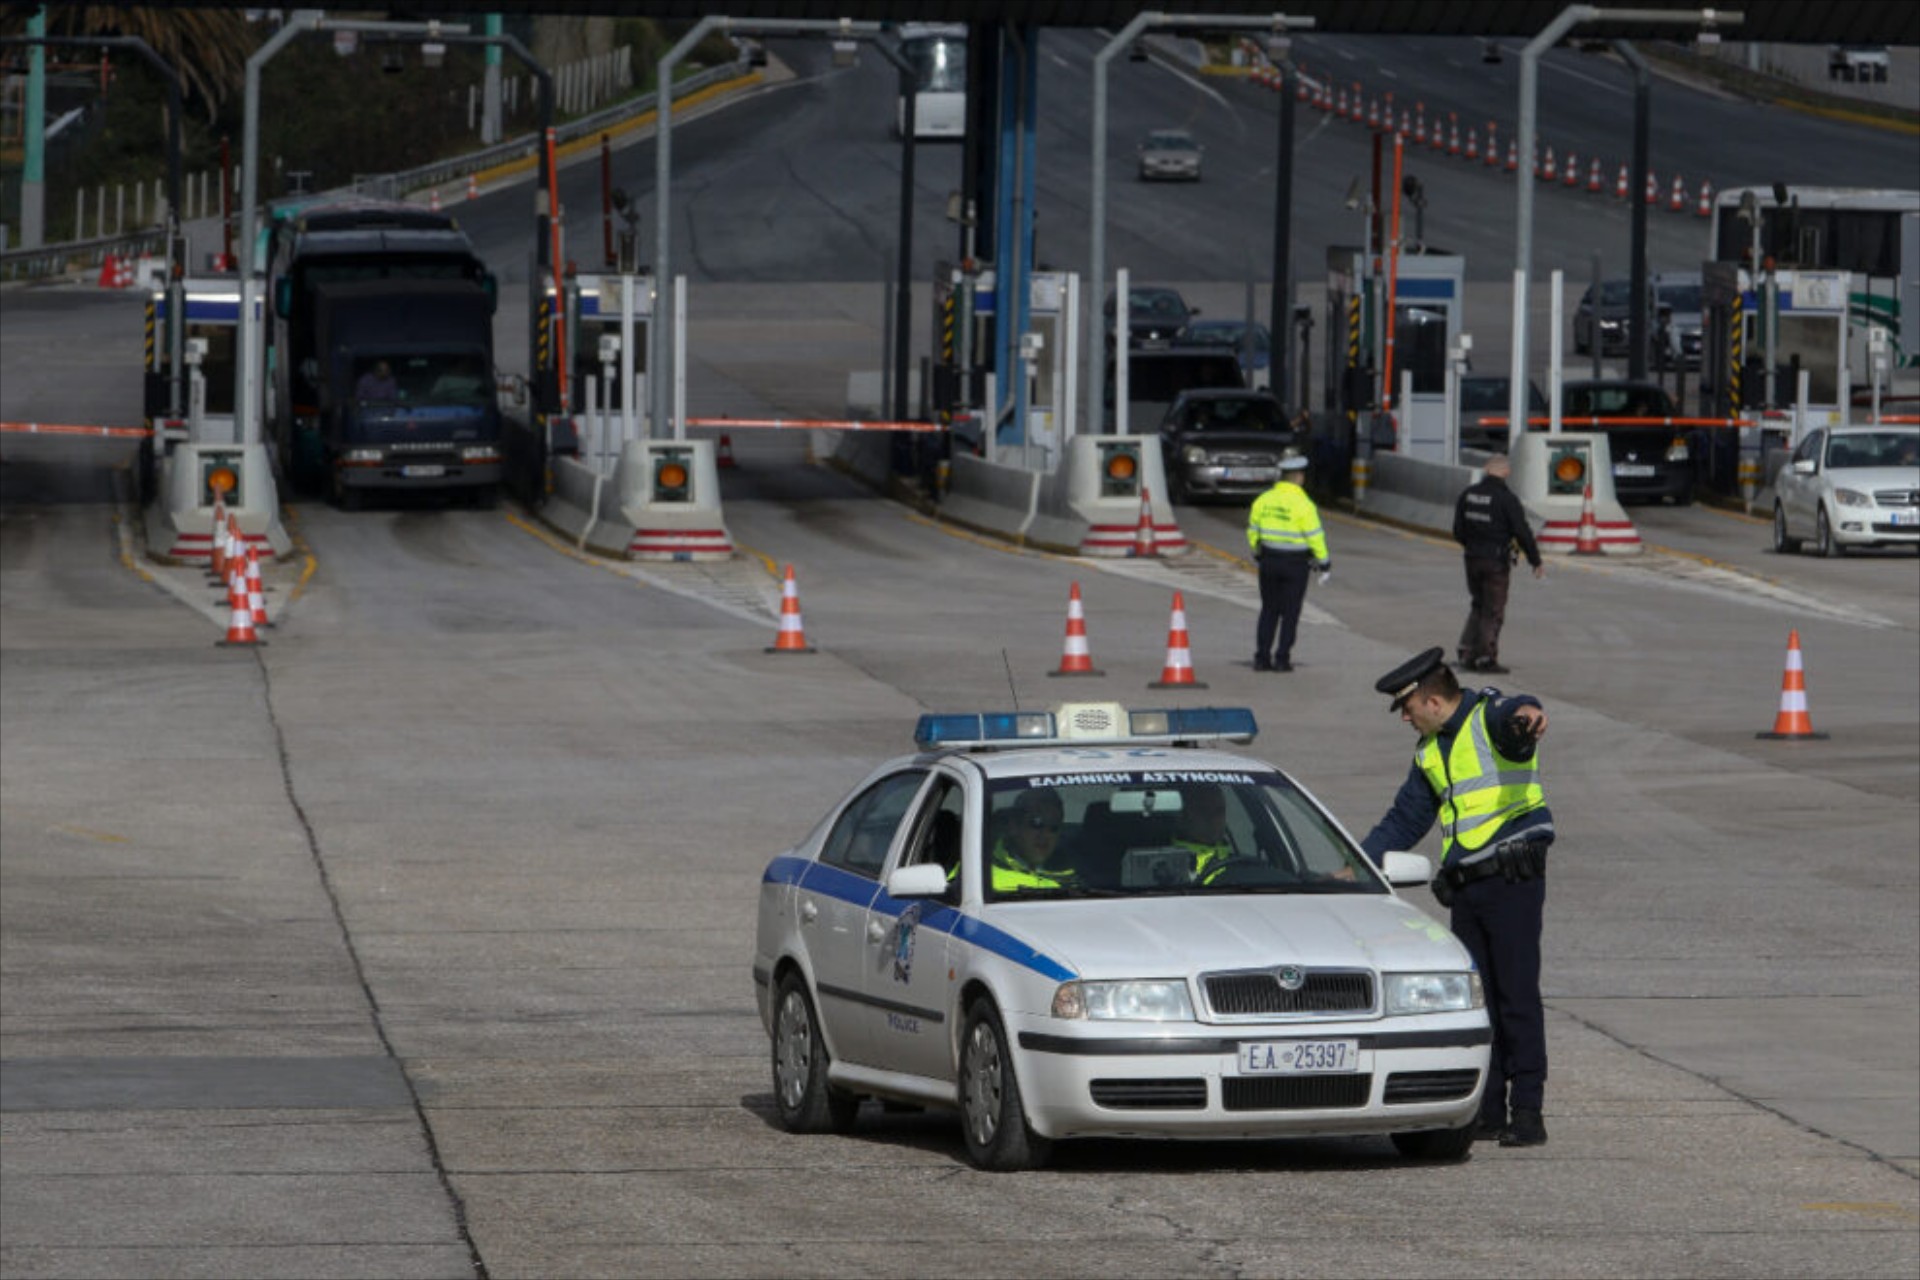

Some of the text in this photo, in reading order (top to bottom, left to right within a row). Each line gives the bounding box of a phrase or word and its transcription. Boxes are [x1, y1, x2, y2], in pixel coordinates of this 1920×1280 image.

[1029, 772, 1255, 788] ΕΛΛΗΝΙΚΗ ΑΣΤΥΝΟΜΙΑ
[1250, 1043, 1347, 1069] EA 25397
